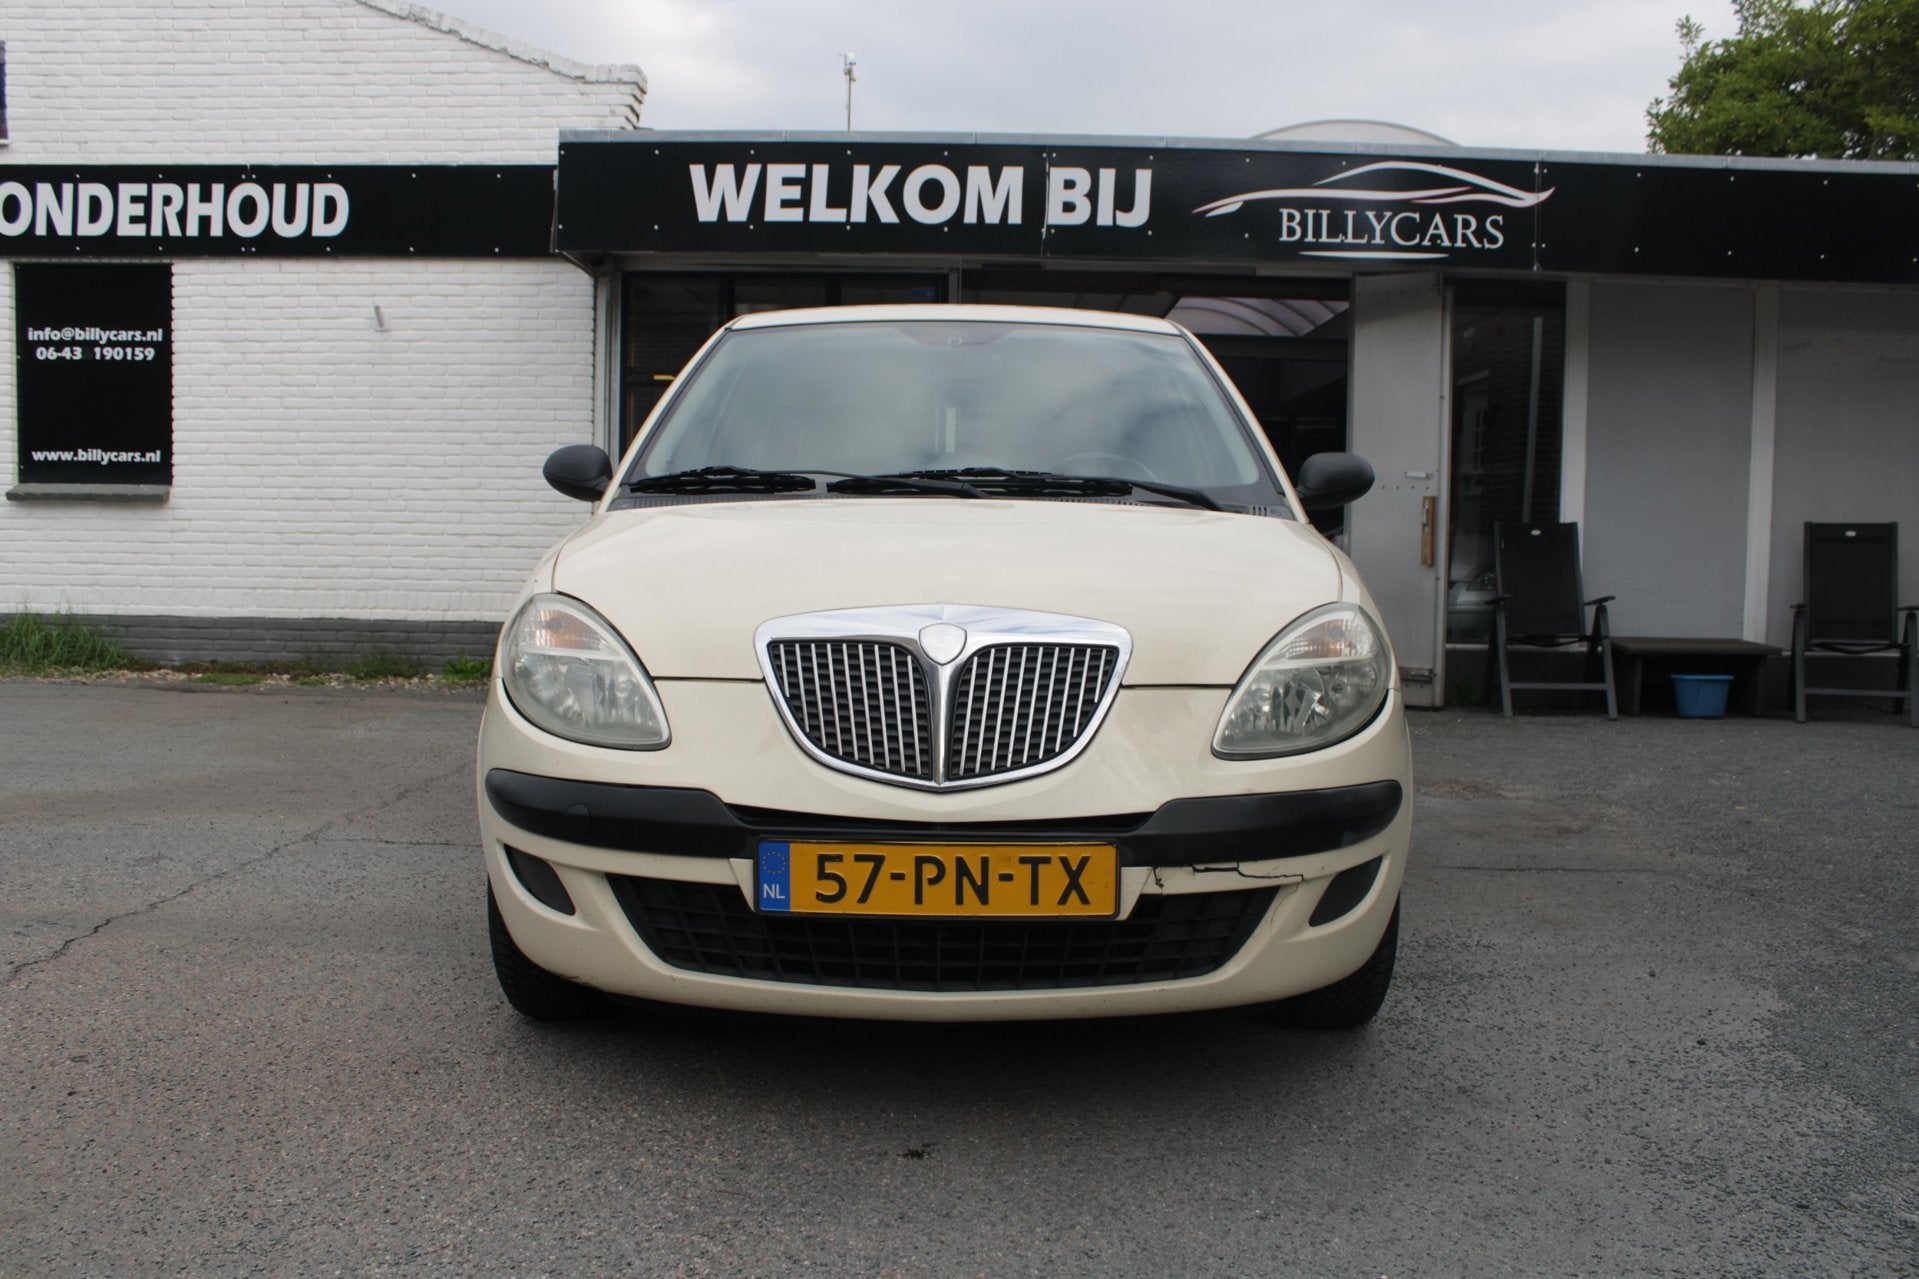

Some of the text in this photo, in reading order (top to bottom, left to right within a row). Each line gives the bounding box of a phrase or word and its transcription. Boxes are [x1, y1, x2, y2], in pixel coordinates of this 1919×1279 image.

[0, 181, 350, 238] ONDERHOUD
[689, 163, 1153, 228] WELKOM BIJ
[1278, 207, 1505, 250] BILLYCARS
[27, 326, 163, 345] info@billycars.nl
[35, 346, 156, 361] 06-43 190159
[31, 448, 161, 466] www.billycars.nl
[763, 853, 1091, 906] NL 57-PN-TX
